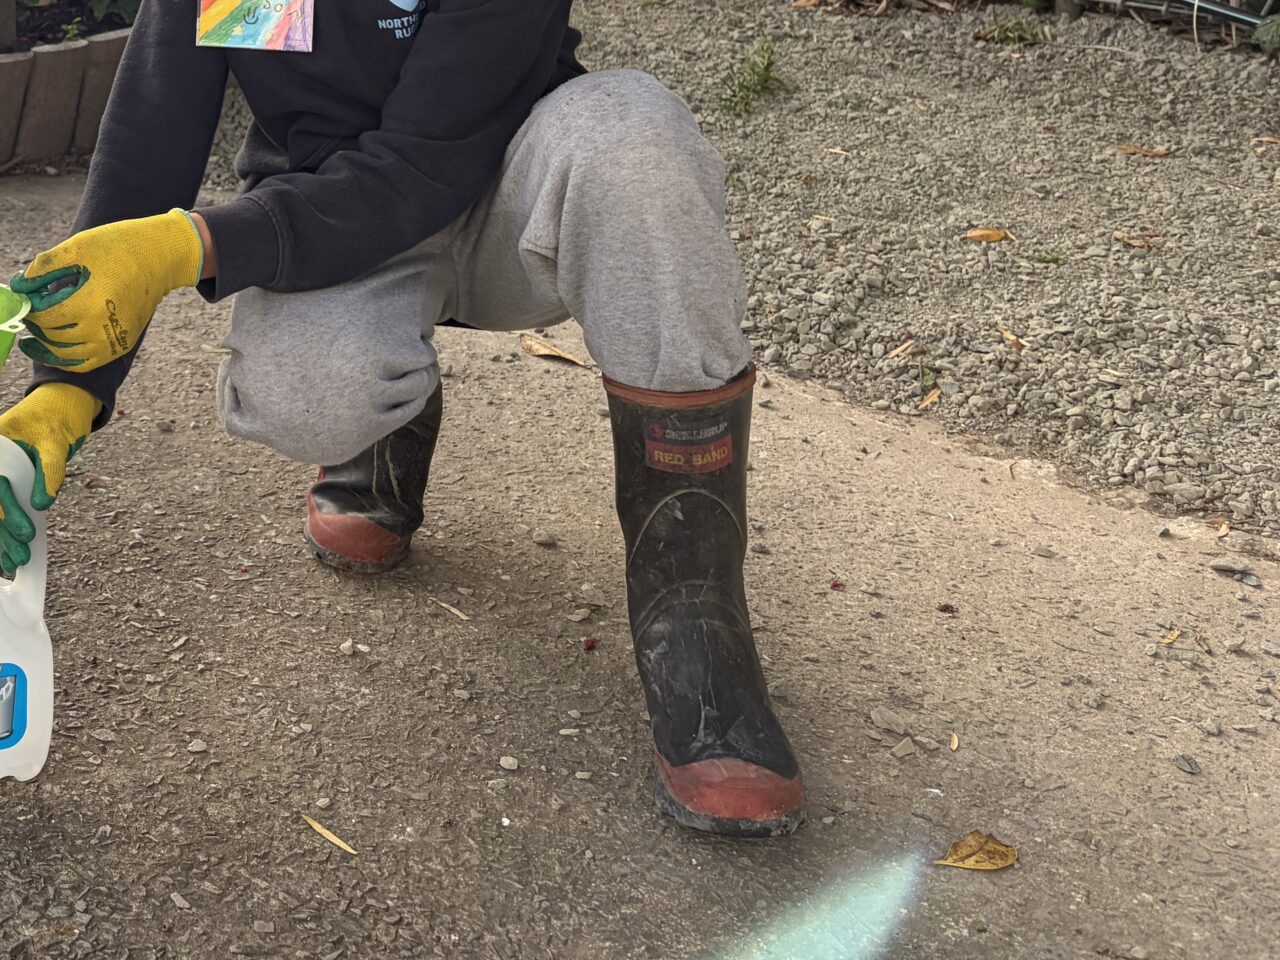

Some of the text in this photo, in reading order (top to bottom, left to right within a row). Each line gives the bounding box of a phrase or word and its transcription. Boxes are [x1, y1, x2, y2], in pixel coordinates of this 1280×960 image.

[377, 13, 418, 29] NORTH
[654, 447, 728, 465] RED BAND
